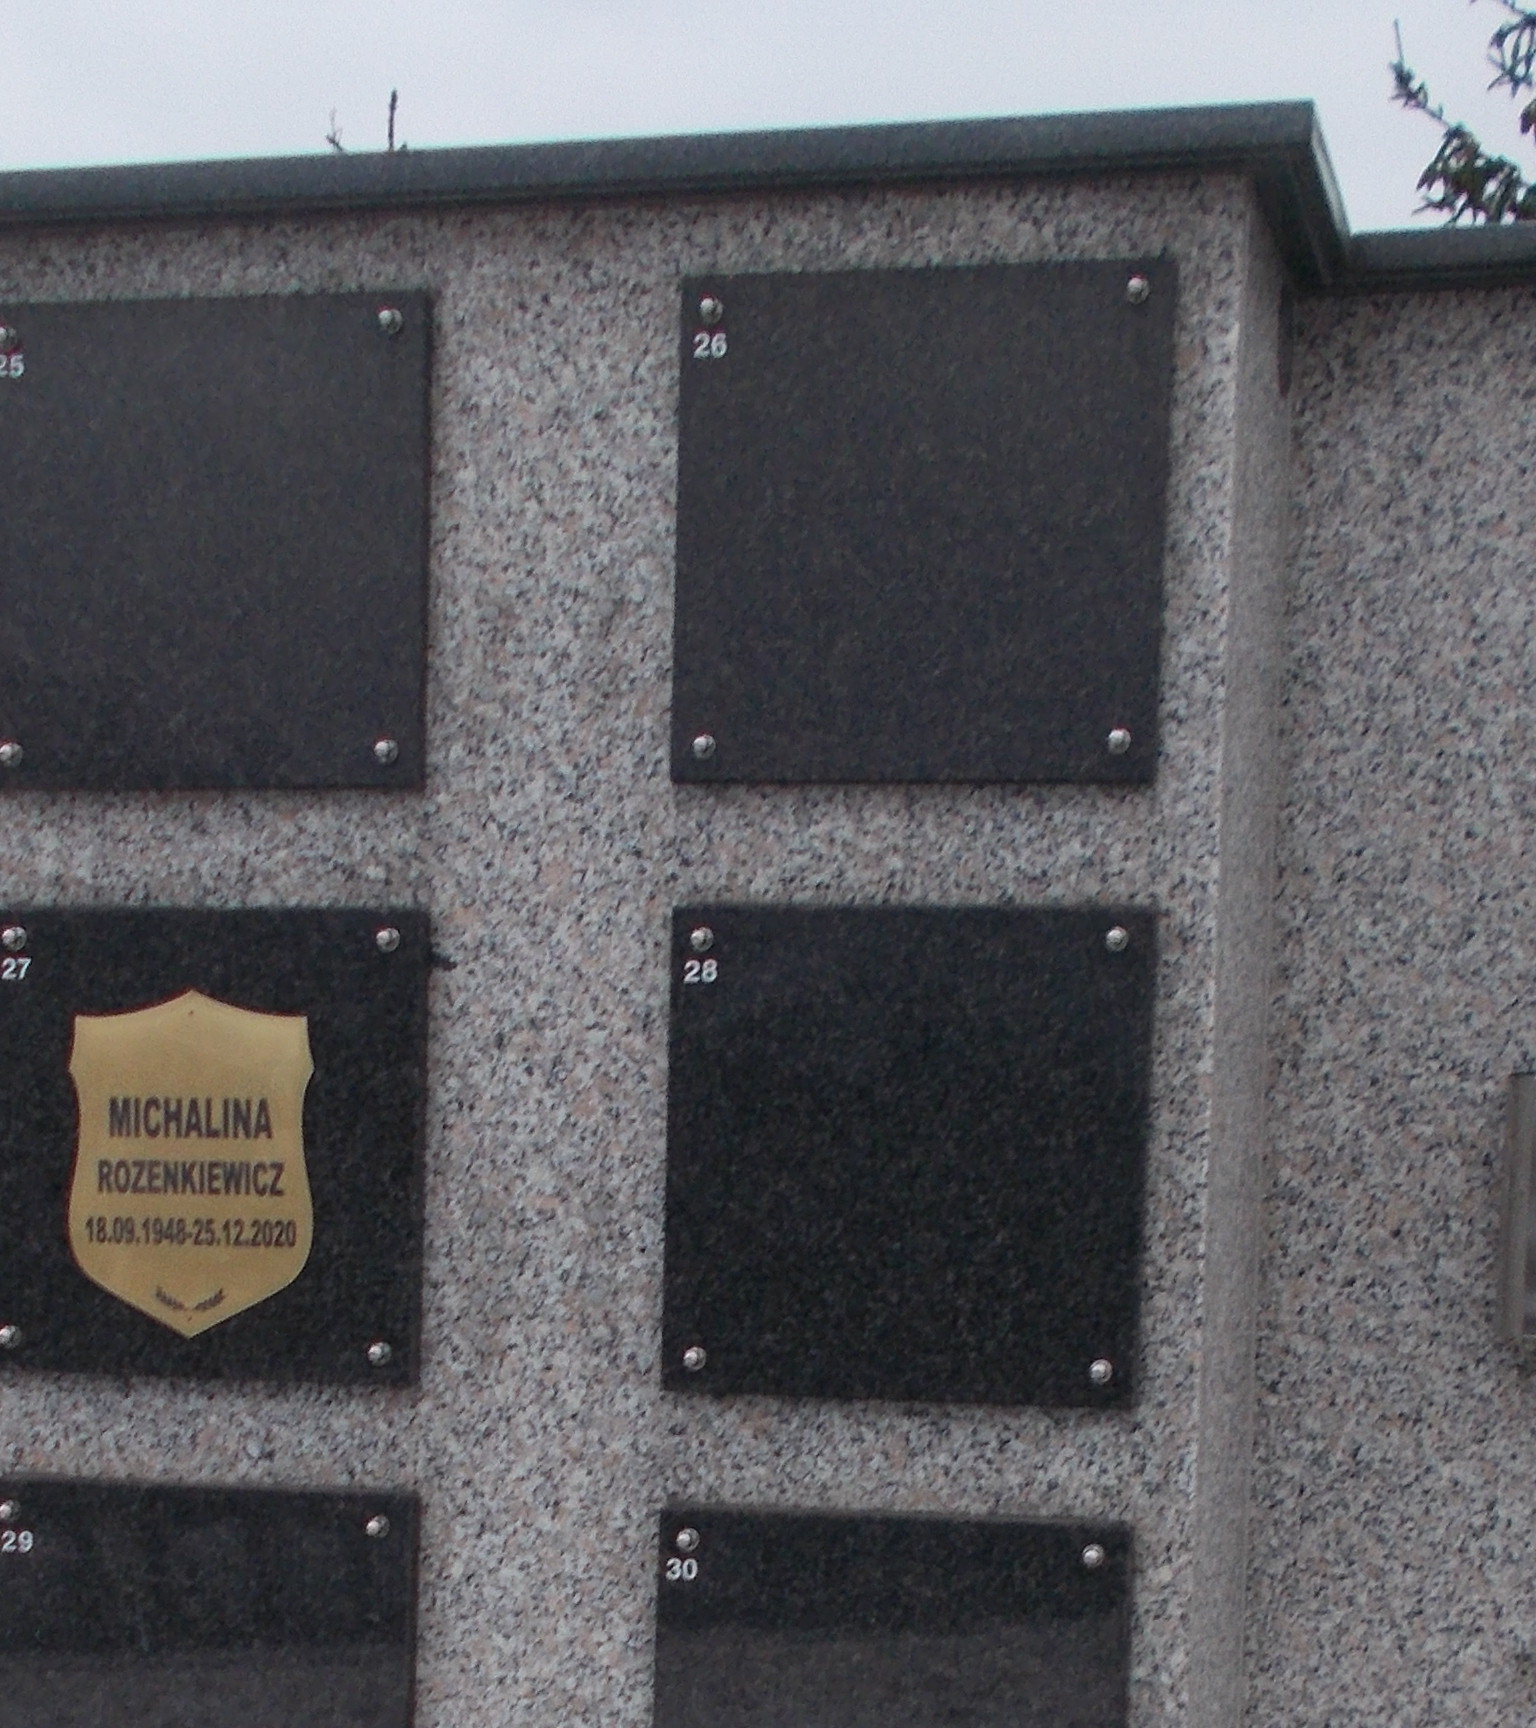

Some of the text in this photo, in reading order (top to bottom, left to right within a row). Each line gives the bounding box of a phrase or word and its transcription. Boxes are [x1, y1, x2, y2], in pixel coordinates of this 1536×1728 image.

[694, 332, 727, 358] 26
[1, 957, 32, 980] 27
[684, 959, 718, 983] 28
[109, 1097, 272, 1139] MICHALINA
[98, 1160, 284, 1197] ROZENKIEWICZ
[1, 1530, 33, 1552] 29
[665, 1557, 698, 1581] 30
